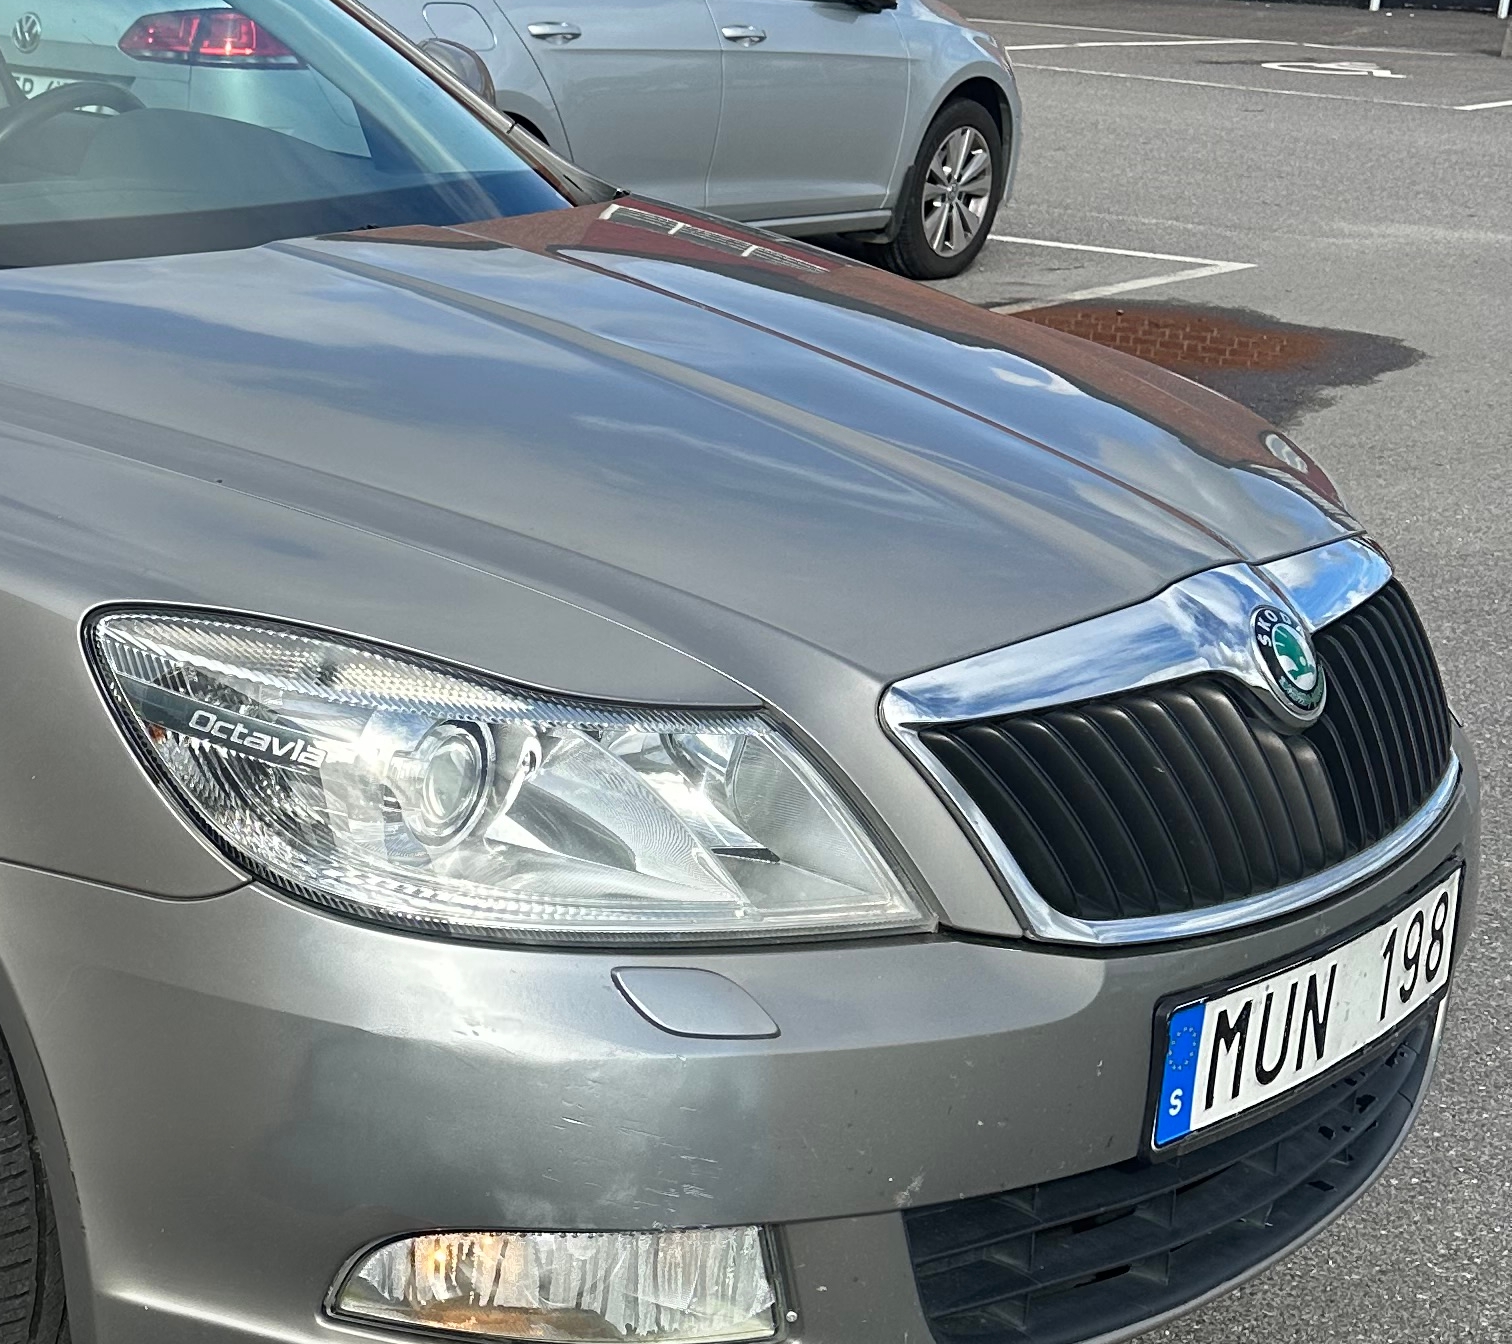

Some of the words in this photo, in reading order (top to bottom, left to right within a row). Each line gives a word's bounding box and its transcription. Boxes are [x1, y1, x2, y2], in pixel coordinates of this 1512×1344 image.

[188, 709, 328, 769] Octavia
[1168, 1087, 1184, 1117] S
[1204, 961, 1338, 1111] MUN
[1379, 890, 1449, 1022] 198
